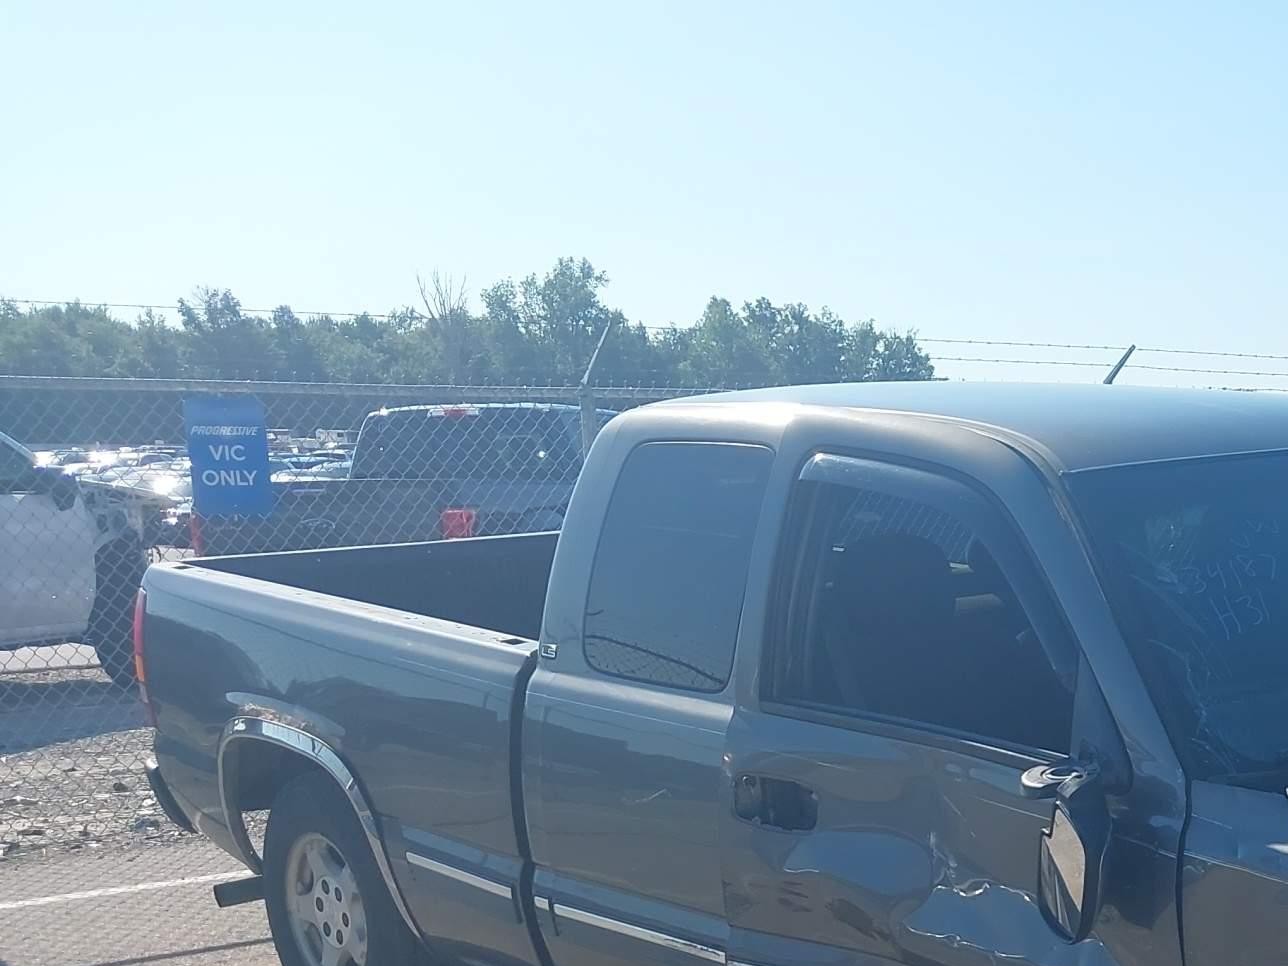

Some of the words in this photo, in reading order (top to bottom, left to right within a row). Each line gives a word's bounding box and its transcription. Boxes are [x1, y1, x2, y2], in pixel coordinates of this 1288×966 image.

[190, 425, 259, 436] PROGRESSIVE
[208, 445, 246, 461] VIC
[202, 469, 258, 486] ONLY
